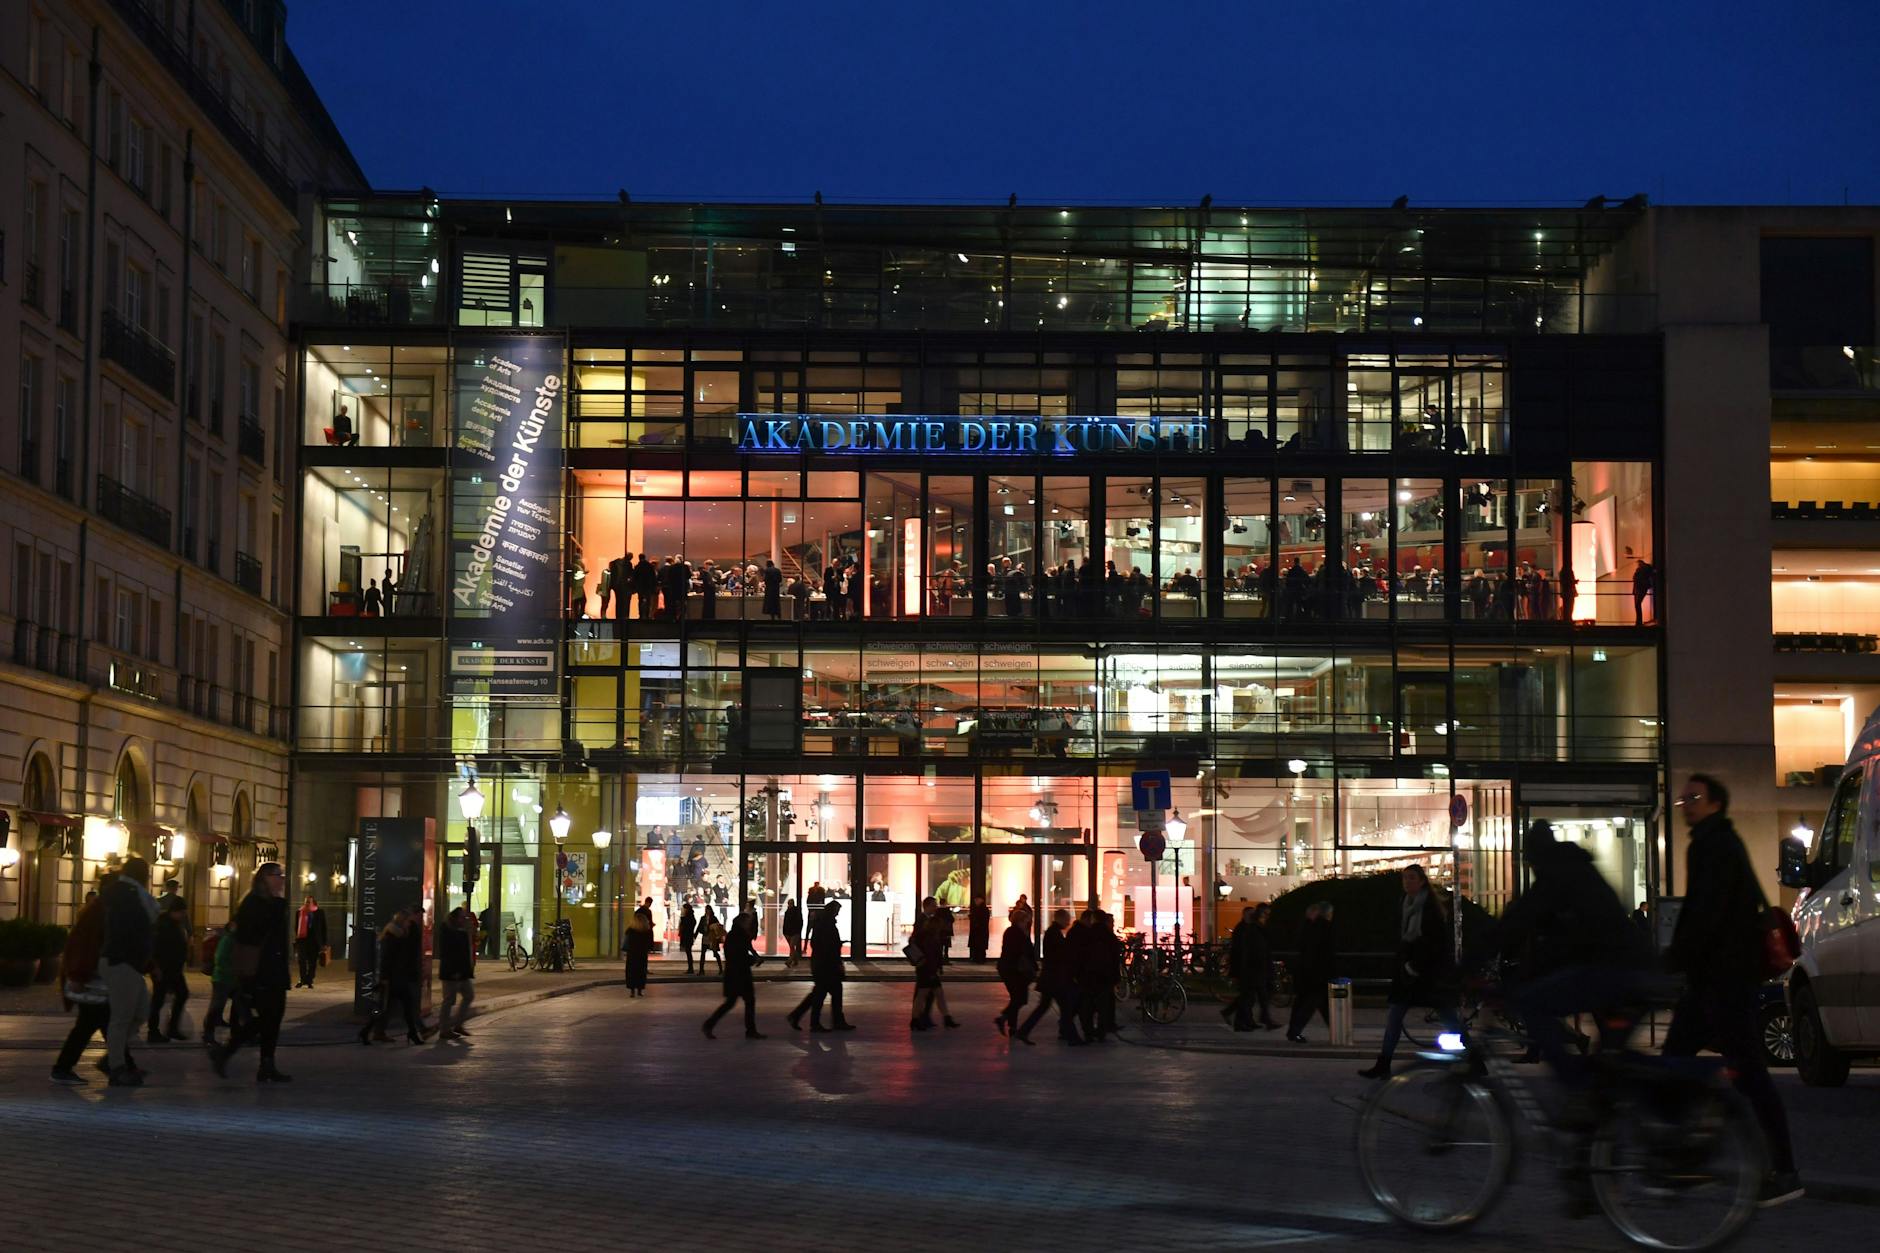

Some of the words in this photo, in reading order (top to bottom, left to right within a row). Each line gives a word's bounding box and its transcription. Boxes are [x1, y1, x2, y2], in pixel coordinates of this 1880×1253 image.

[491, 355, 522, 373] Academy
[497, 365, 512, 375] Arts
[512, 375, 561, 453] Künste
[739, 421, 946, 451] AKADEMIE
[963, 422, 1038, 452] DER
[1052, 416, 1209, 453] KÜNSTE
[499, 453, 528, 492] der
[453, 495, 511, 606] Akademie
[491, 602, 506, 612] Arts
[867, 659, 915, 669] schweigen
[984, 660, 1032, 669] schweigen
[363, 822, 377, 881] KÜNSTE
[363, 886, 376, 916] DER
